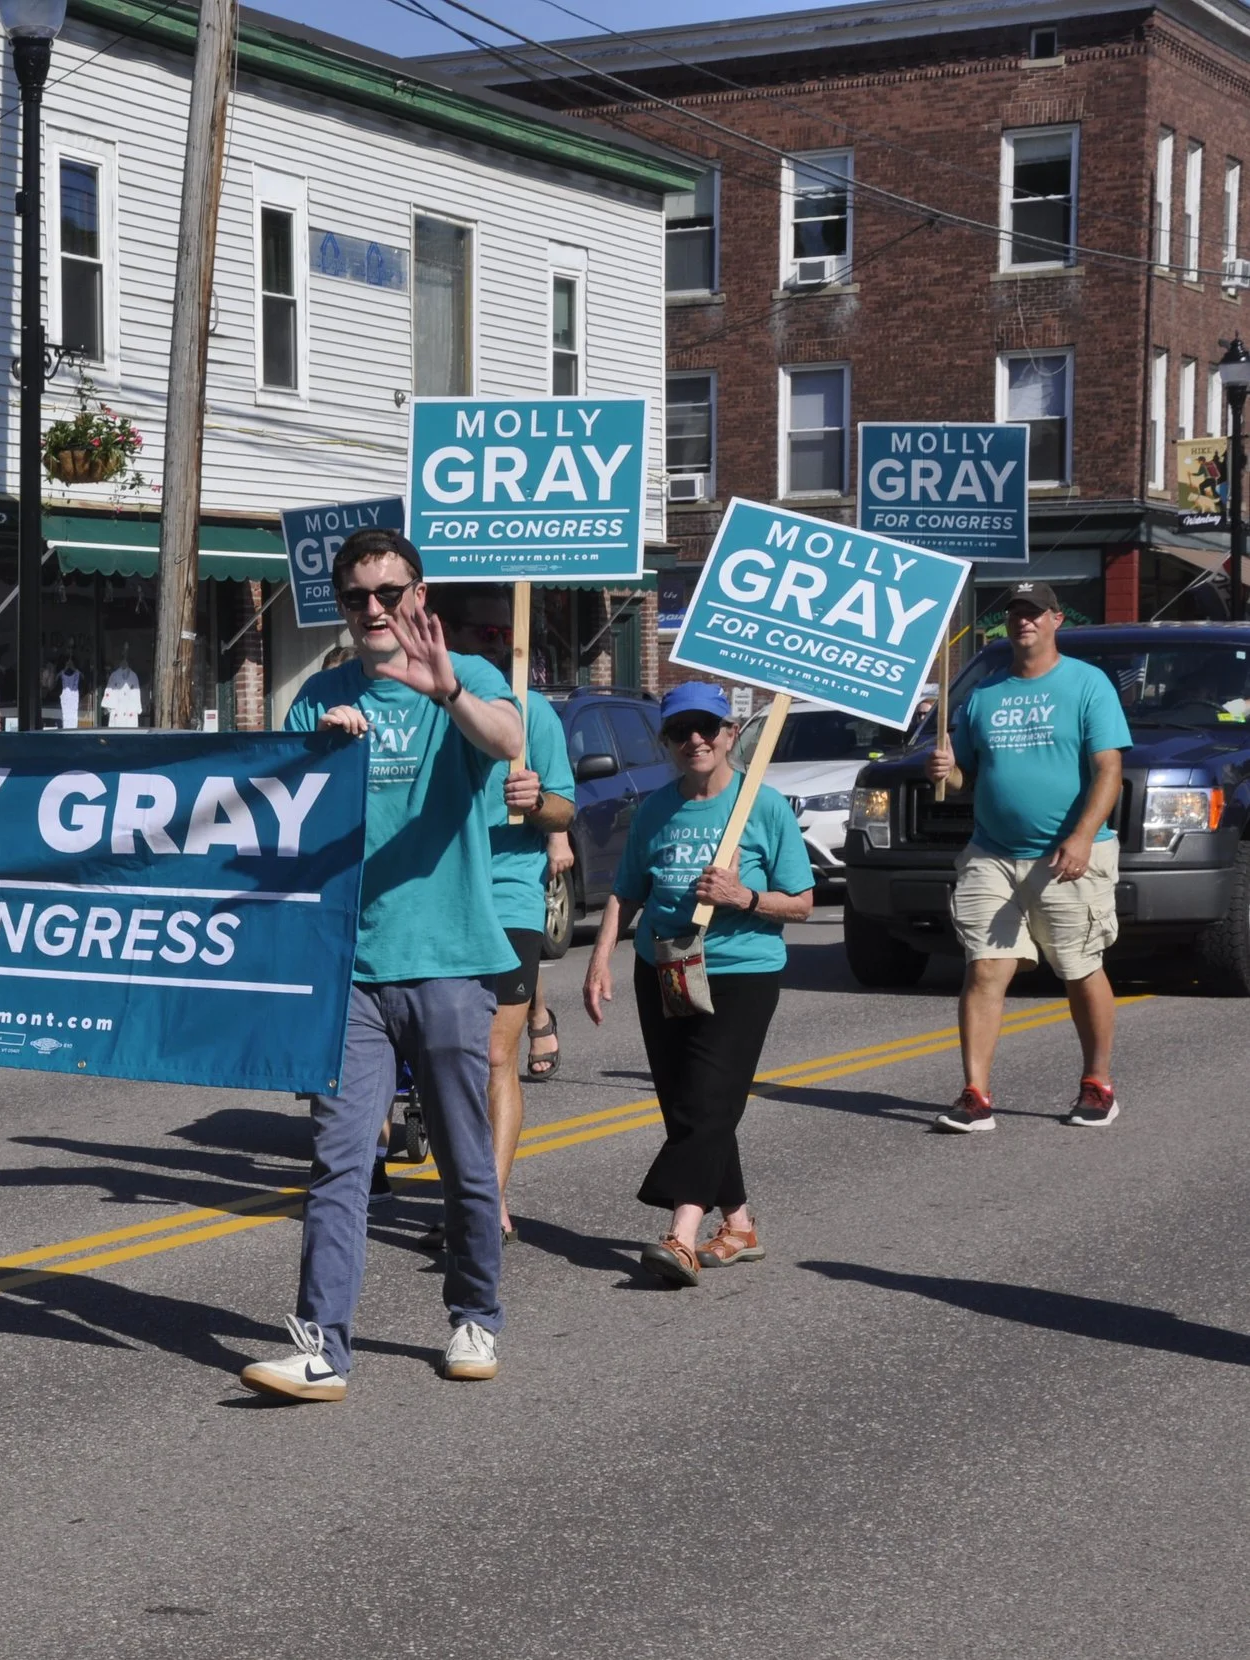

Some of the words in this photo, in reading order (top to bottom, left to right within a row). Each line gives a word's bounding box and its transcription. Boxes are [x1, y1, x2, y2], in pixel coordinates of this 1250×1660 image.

[456, 408, 601, 438] MOLLY
[891, 432, 995, 454] MOLLY
[421, 444, 633, 504] GRAY
[868, 458, 1018, 503] GRAY
[304, 506, 380, 533] MOLLY
[428, 521, 479, 539] FOR
[488, 518, 623, 539] CONGRESS
[873, 513, 910, 528] FOR
[915, 515, 1013, 530] CONGRESS
[449, 552, 599, 564] mollyforvermont.com
[764, 520, 918, 582] MOLLY
[305, 585, 330, 599] FOR
[718, 548, 939, 646] GRAY
[706, 613, 760, 640] FOR
[765, 629, 905, 683] CONGRESS
[719, 648, 870, 698] mollyforvermont.com
[1001, 693, 1050, 707] MOLLY
[990, 704, 1056, 727] GRAY
[1009, 731, 1053, 742] VERMONT
[37, 770, 331, 858] GRAY
[670, 827, 723, 841] MOLLY
[662, 843, 719, 864] GRA
